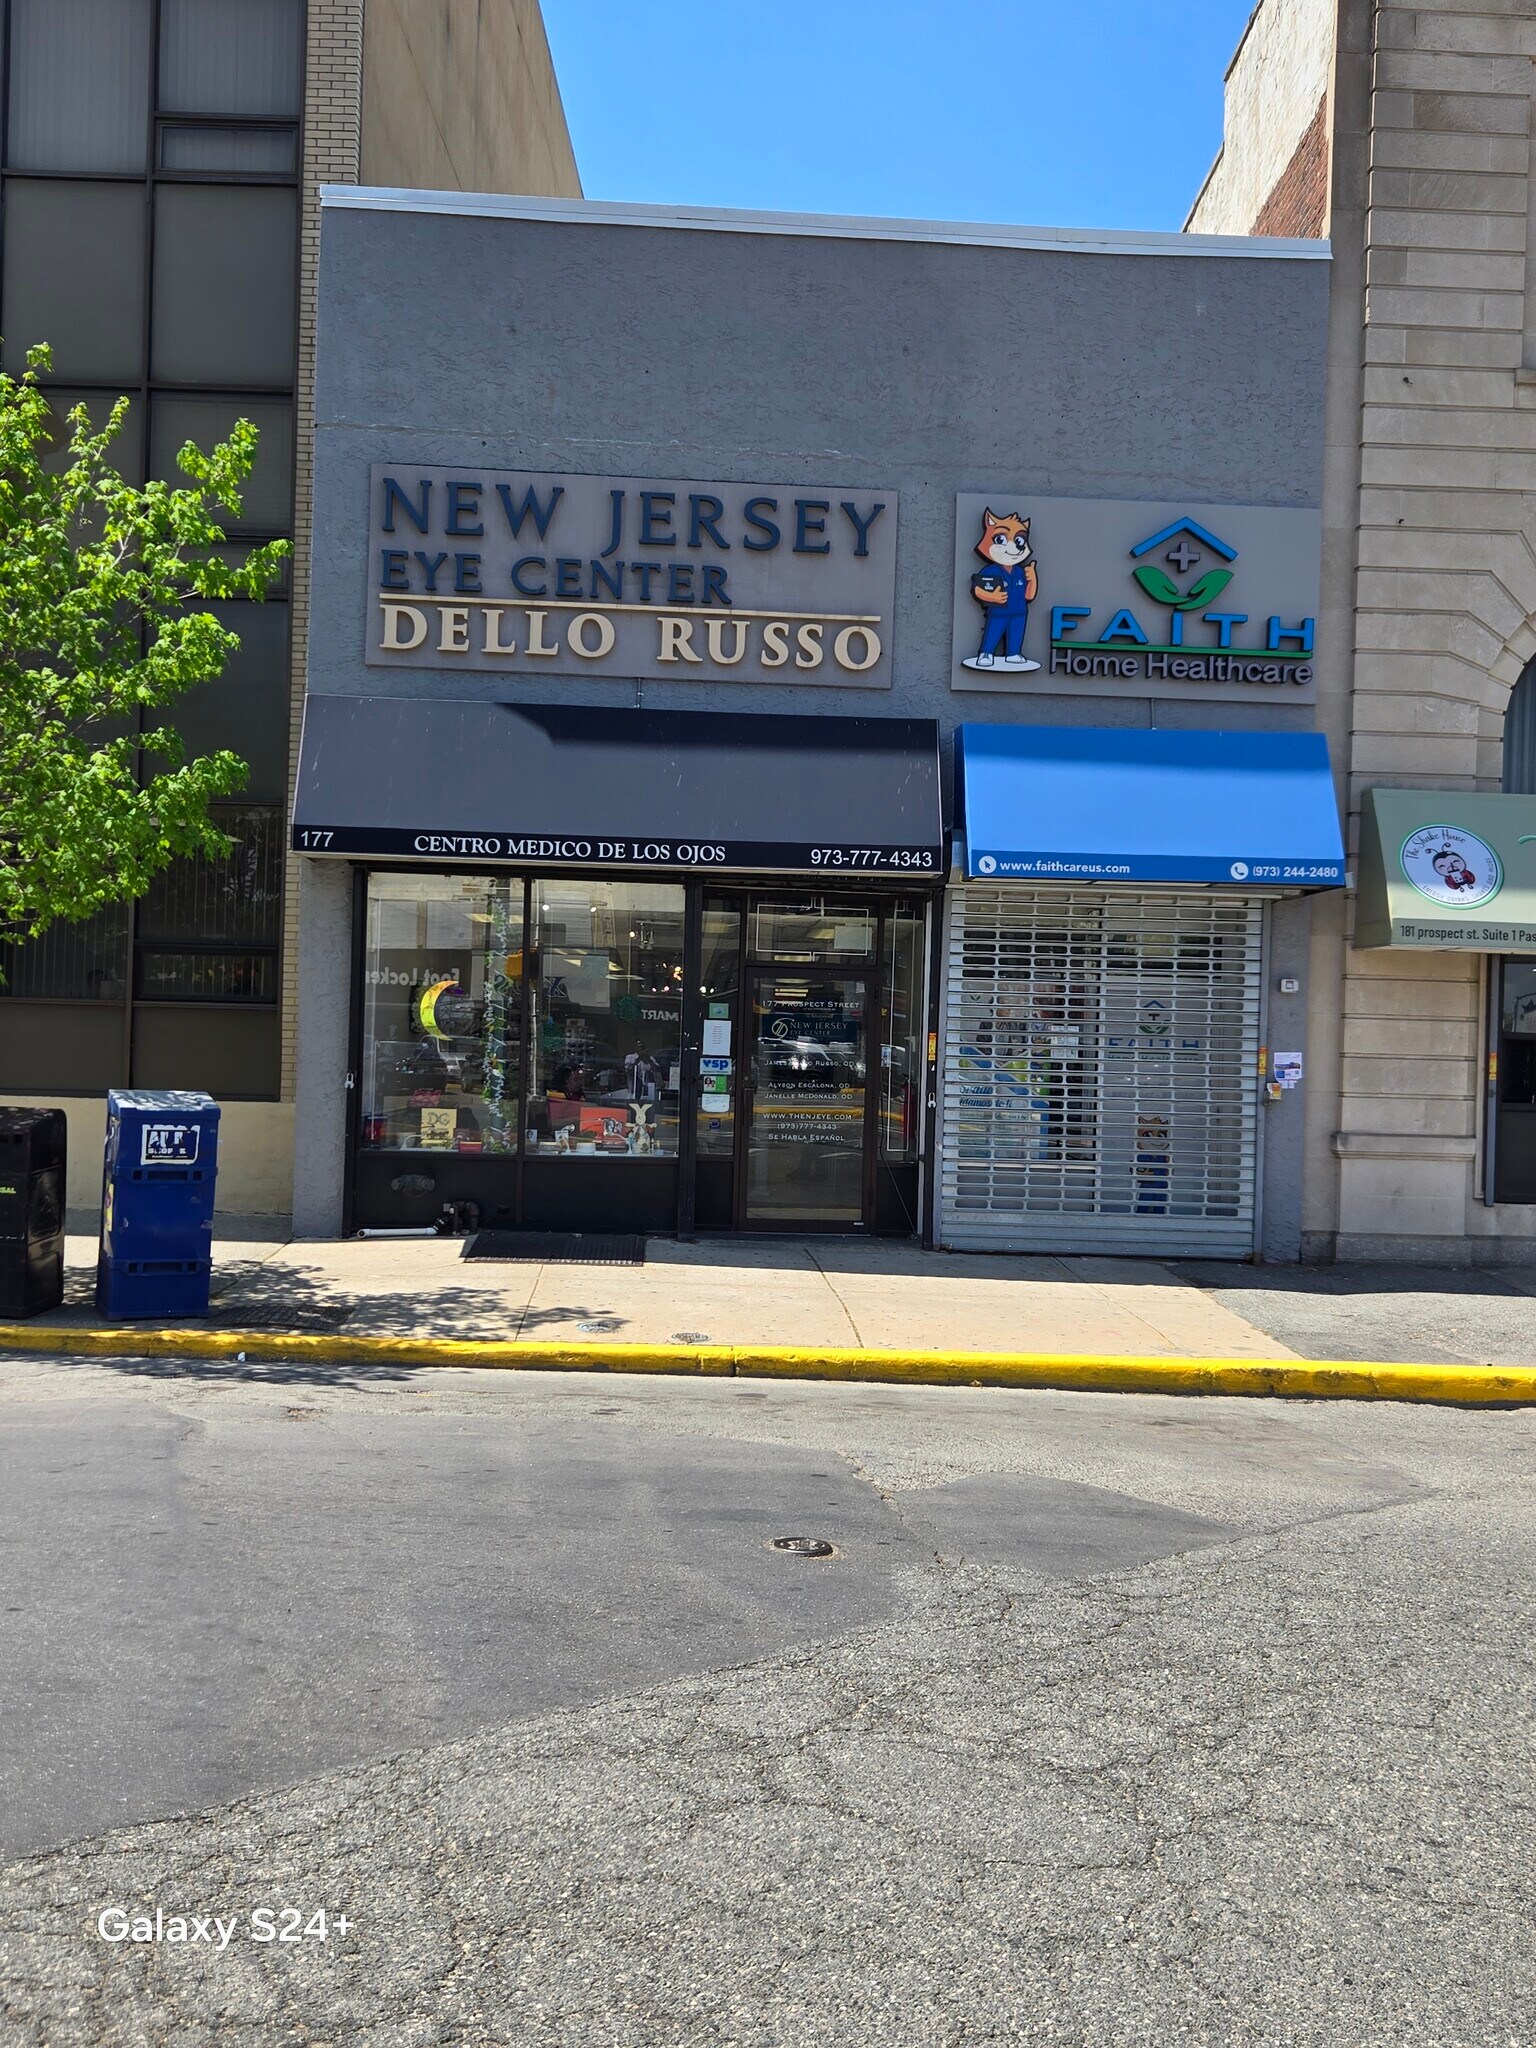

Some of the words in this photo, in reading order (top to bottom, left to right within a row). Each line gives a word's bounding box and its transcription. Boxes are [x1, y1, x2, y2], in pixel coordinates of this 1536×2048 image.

[382, 478, 565, 541] NEW
[600, 490, 885, 557] JERSEY
[380, 549, 483, 592] EYE
[511, 556, 732, 604] CENTER
[379, 604, 616, 658] DELLO
[656, 617, 882, 670] RUSSO
[1050, 606, 1314, 651] FAITH
[1050, 649, 1139, 677] Home
[1146, 653, 1313, 685] Healthcare
[299, 831, 334, 848] 177
[414, 835, 500, 855] CENTRO
[507, 838, 592, 857] MEDICO
[598, 840, 627, 858] DE
[633, 841, 671, 860] LOS
[676, 844, 726, 862] OJOS
[811, 848, 933, 867] 973-777-4343
[1000, 859, 1130, 875] www.faithcareus.com
[1252, 866, 1280, 879] (973)
[1283, 866, 1338, 879] 244-2480
[1400, 925, 1415, 937] 181
[1418, 928, 1464, 940] prospect
[1466, 929, 1480, 940] st.
[1482, 928, 1509, 940] Suite
[1511, 930, 1516, 941] 1
[815, 1022, 848, 1030] JERSEY
[703, 1060, 729, 1071] vsp
